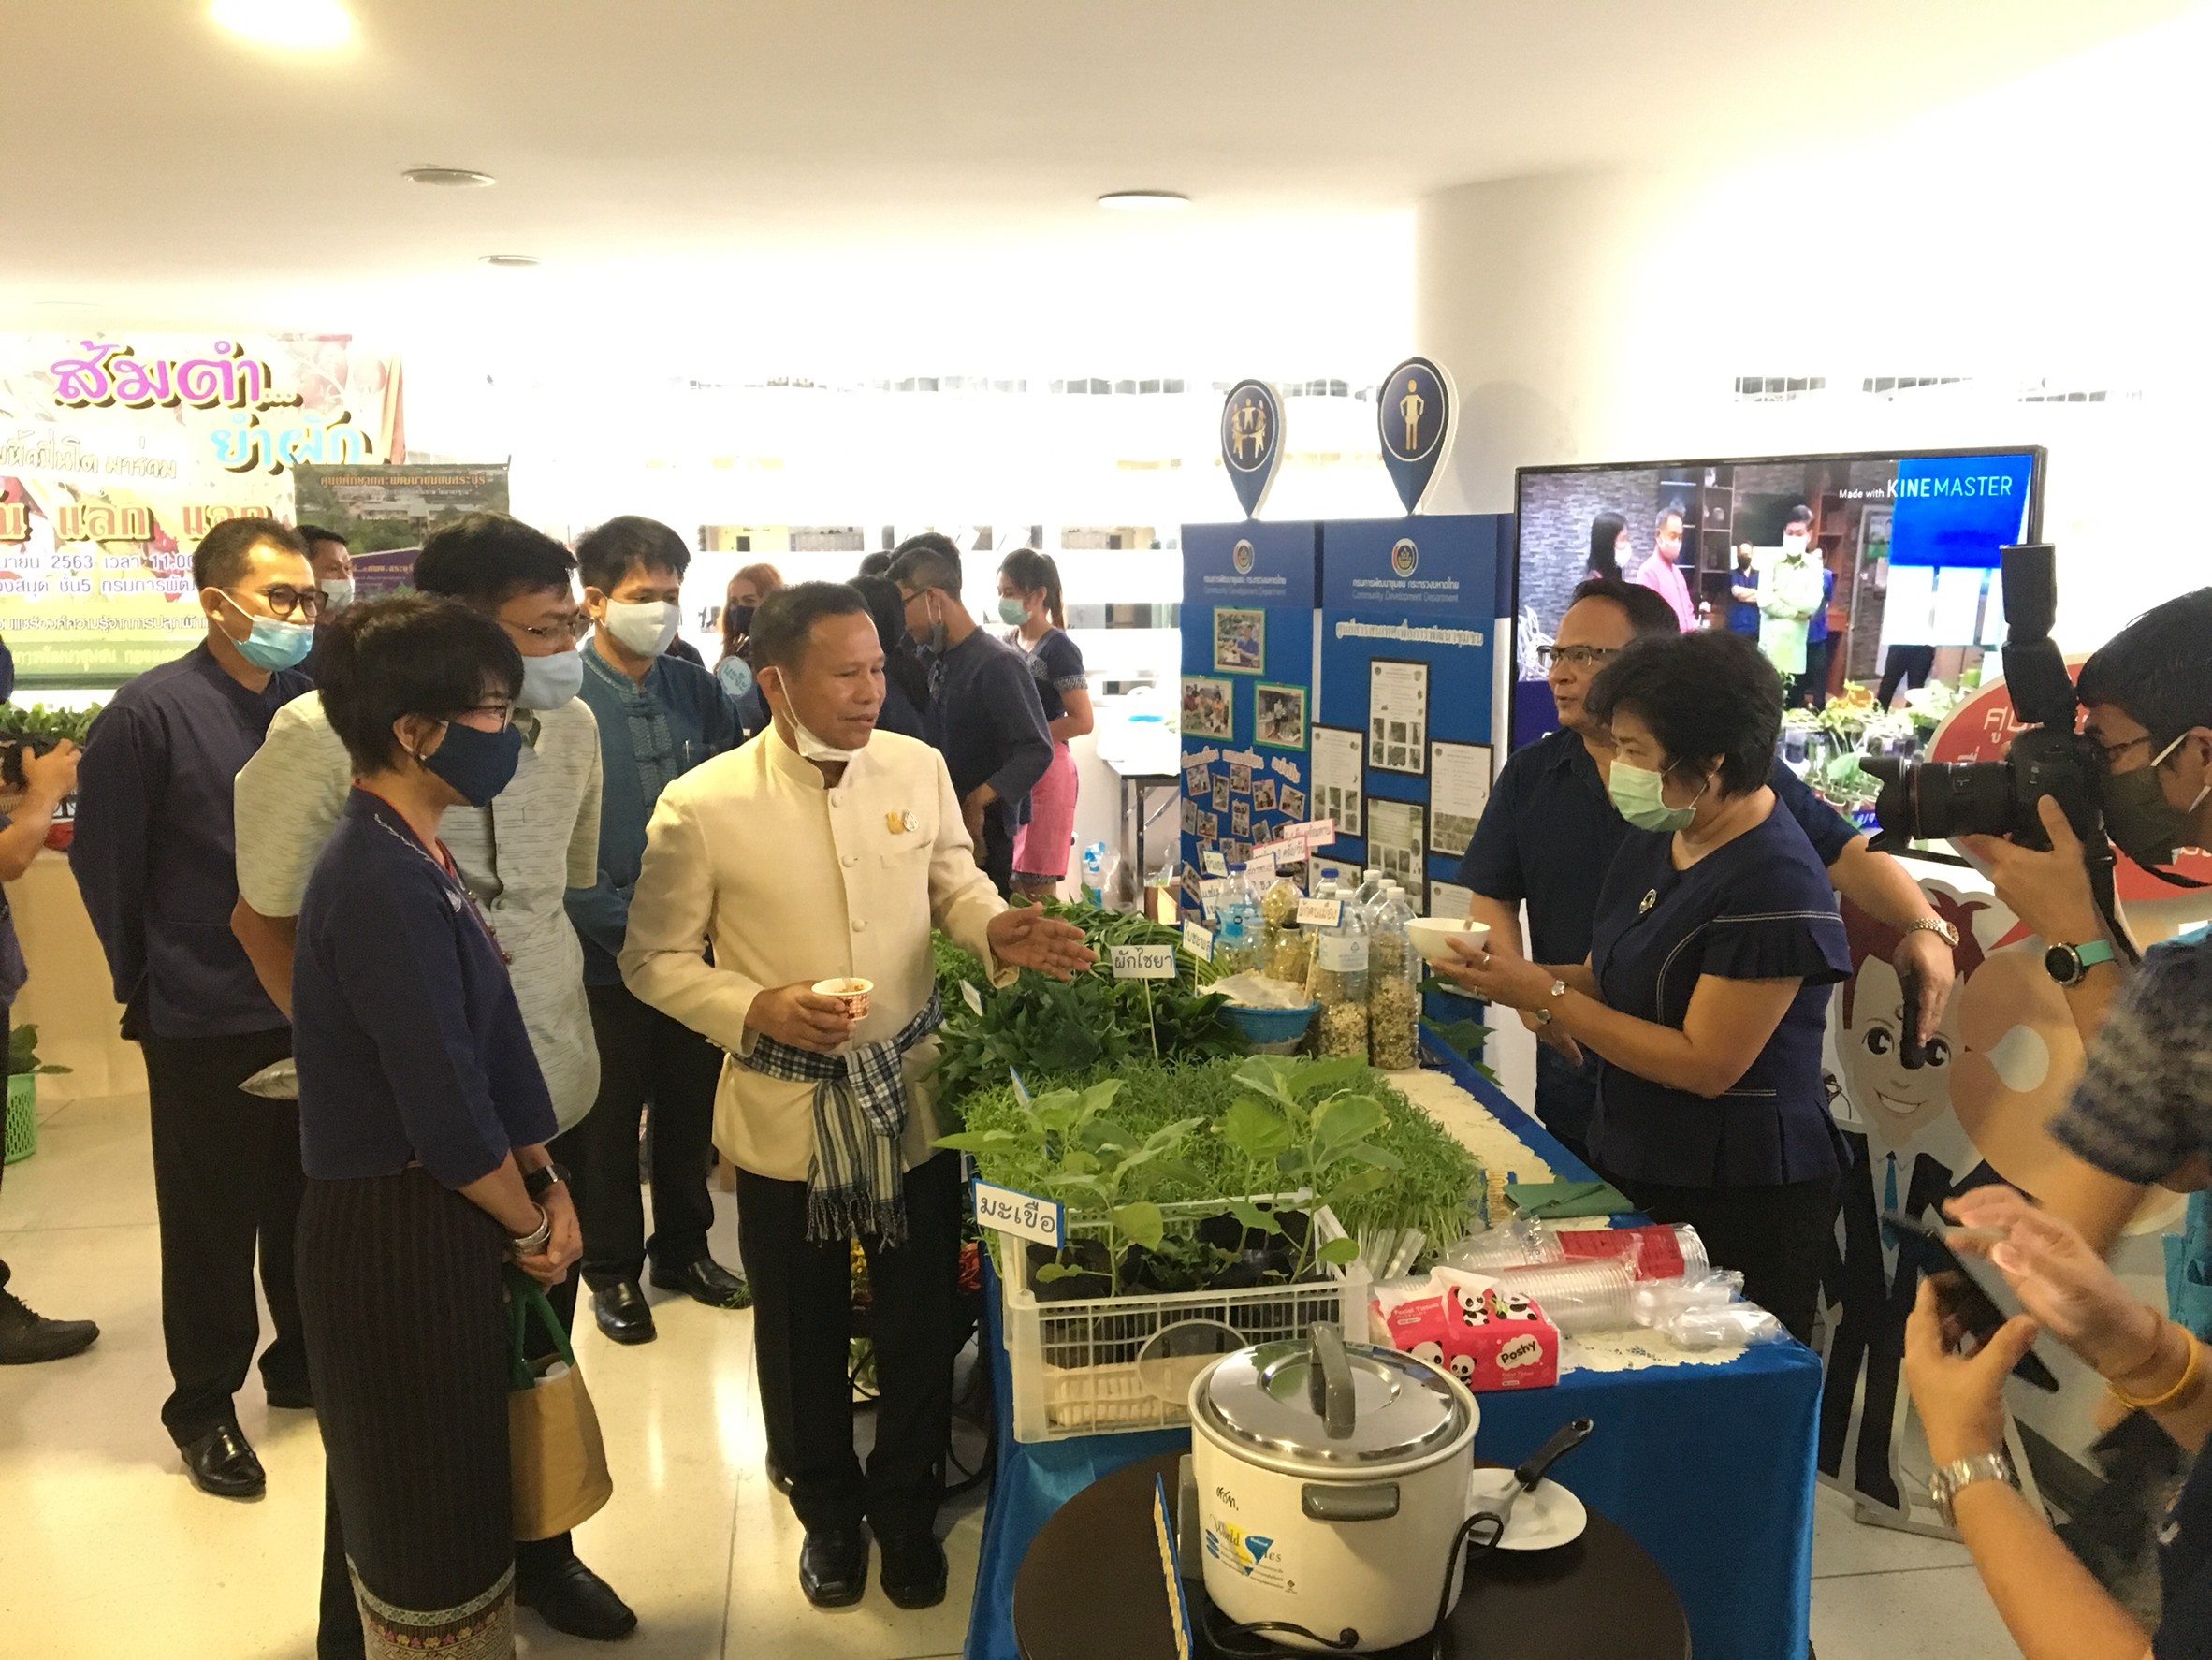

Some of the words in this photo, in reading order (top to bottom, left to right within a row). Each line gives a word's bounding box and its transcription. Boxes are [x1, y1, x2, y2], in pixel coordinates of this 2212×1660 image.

[211, 413, 362, 466] ยำผัก
[1839, 489, 1863, 499] Made
[1865, 489, 1885, 499] with
[1886, 475, 2013, 498] KINEMASTER
[58, 506, 147, 538] แลก
[51, 555, 93, 569] 2563
[104, 556, 140, 569] เวลา
[1114, 946, 1173, 968] ผักไชยา
[980, 1197, 1056, 1233] มะเขือ
[1500, 1340, 1536, 1364] Poshy
